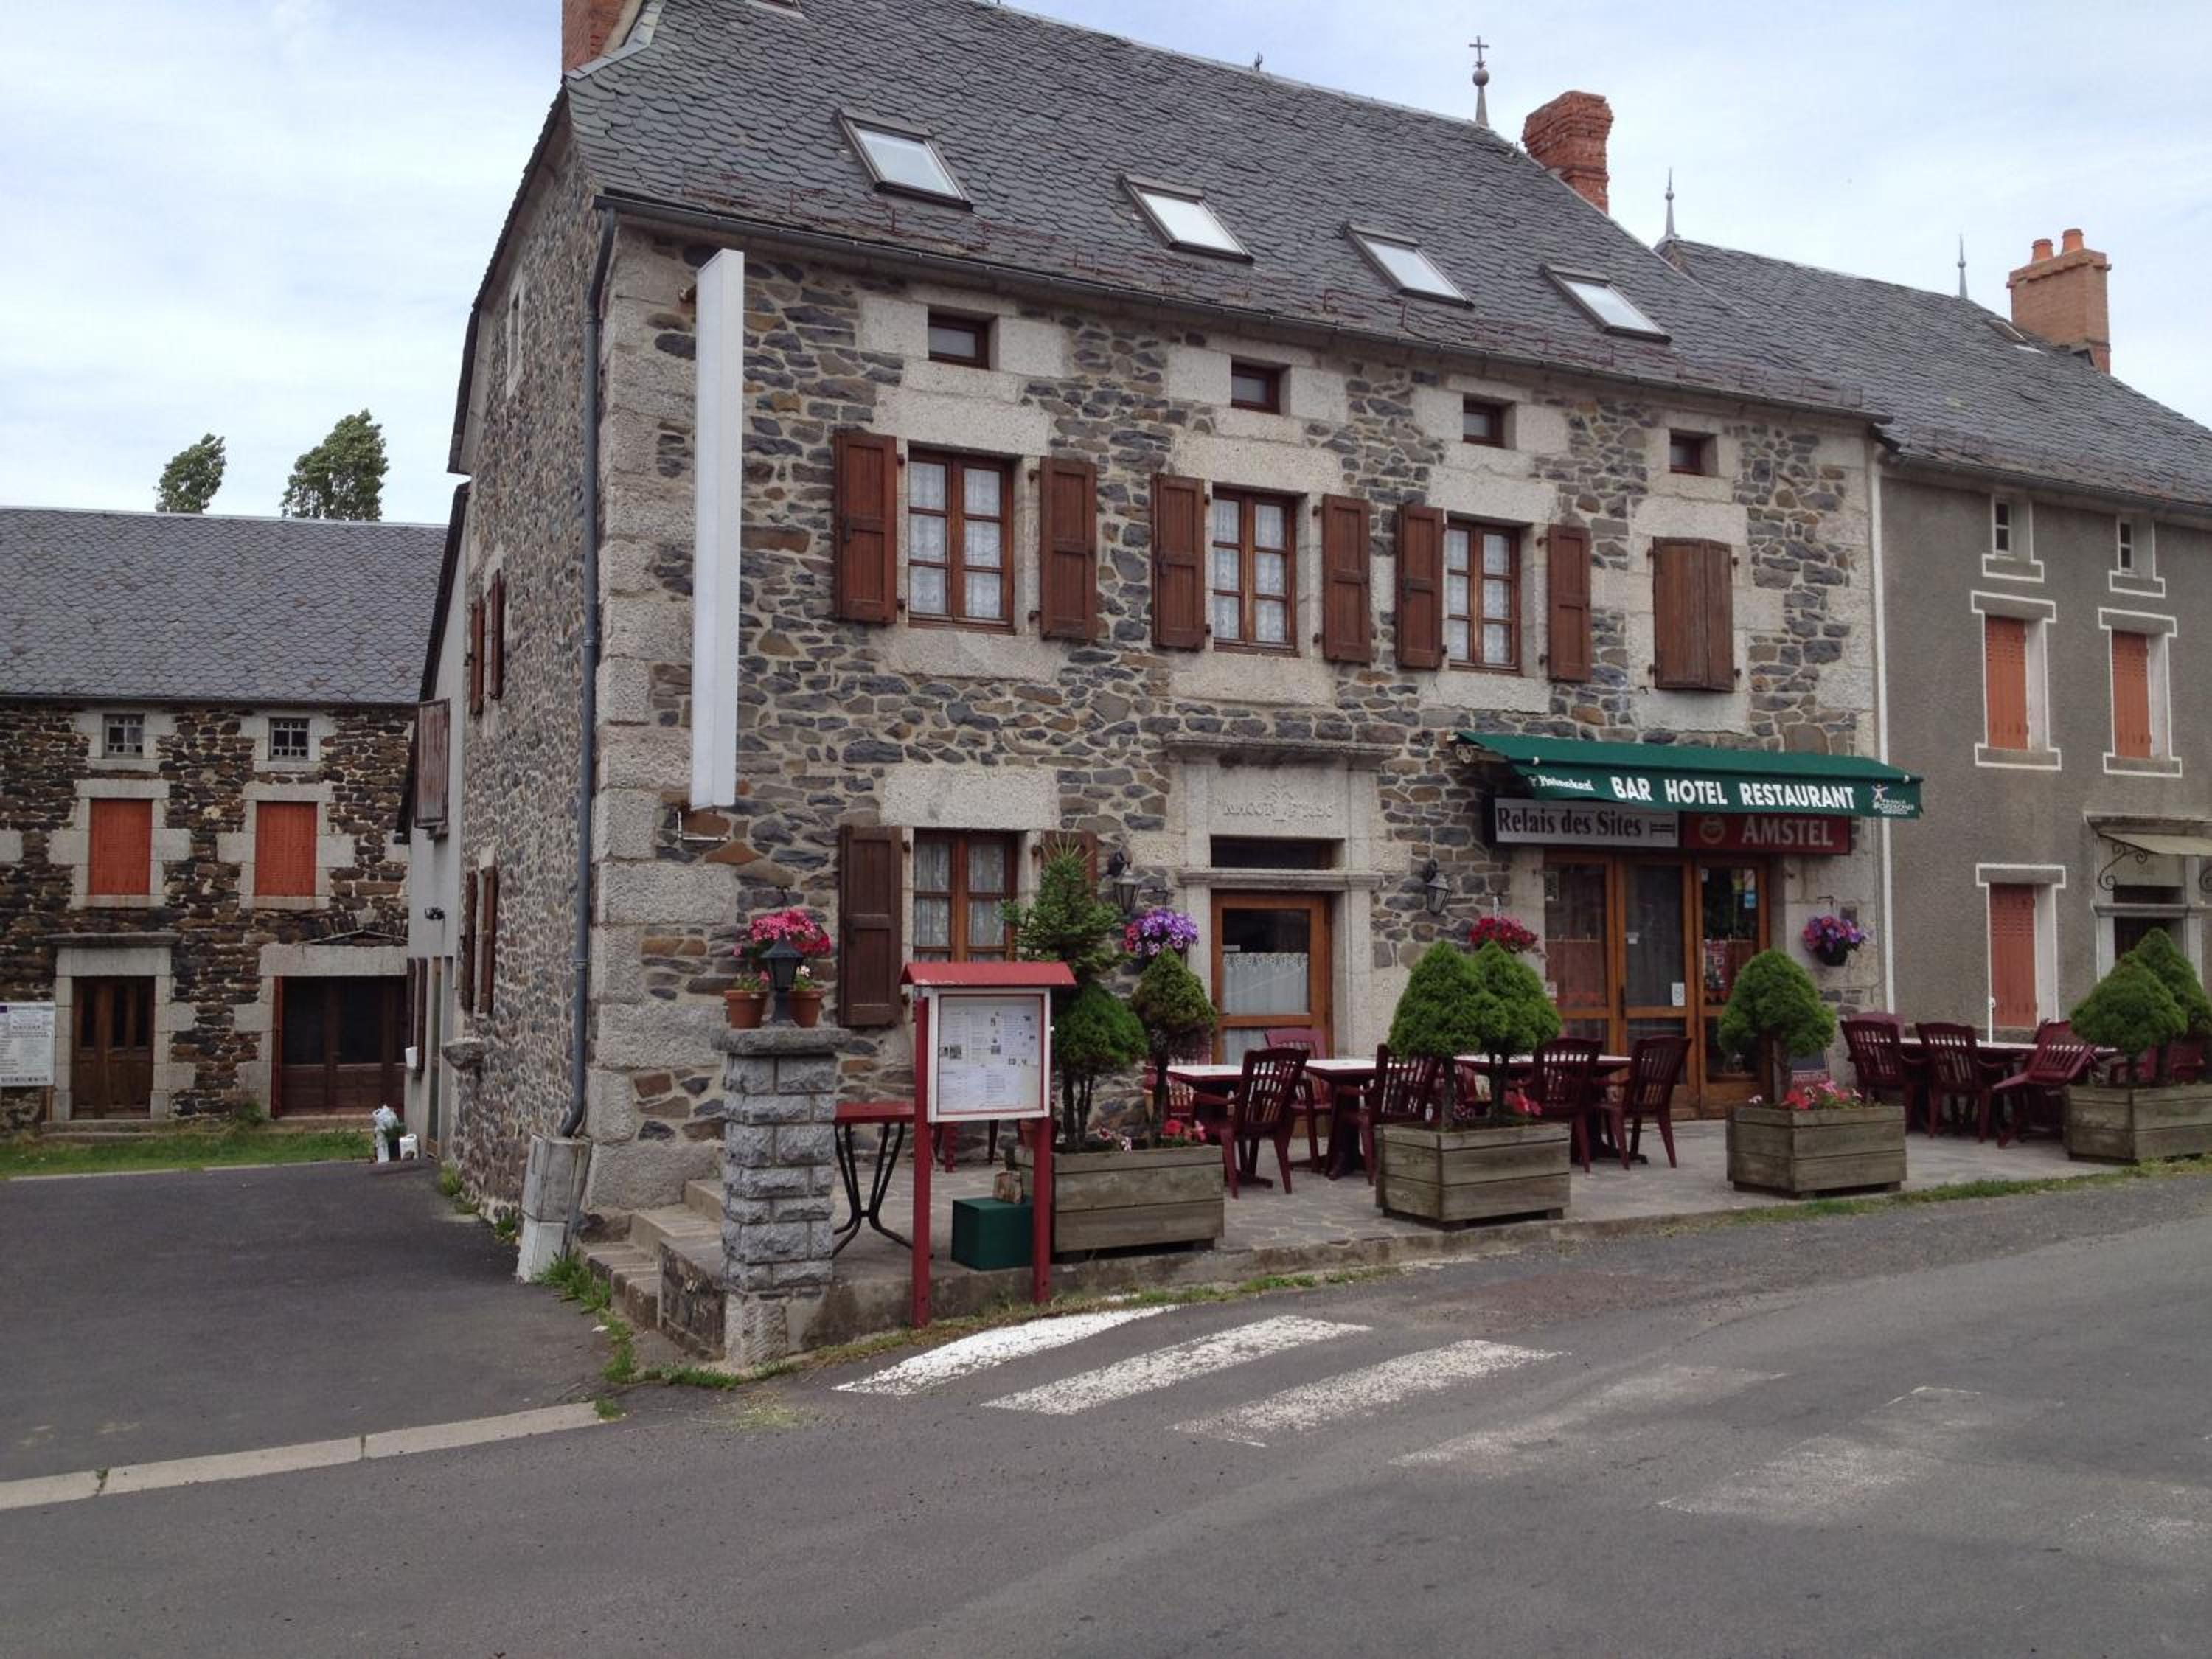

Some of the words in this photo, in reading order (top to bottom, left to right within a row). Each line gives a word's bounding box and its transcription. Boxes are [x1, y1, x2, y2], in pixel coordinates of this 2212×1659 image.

[1610, 776, 1652, 801] BAR
[1664, 779, 1728, 805] HOTEL
[1739, 782, 1855, 810] RESTAURANT
[1497, 807, 1556, 834] Relais
[1561, 810, 1591, 835] des
[1596, 810, 1642, 837] Sites
[1740, 815, 1834, 847] AMSTEL
